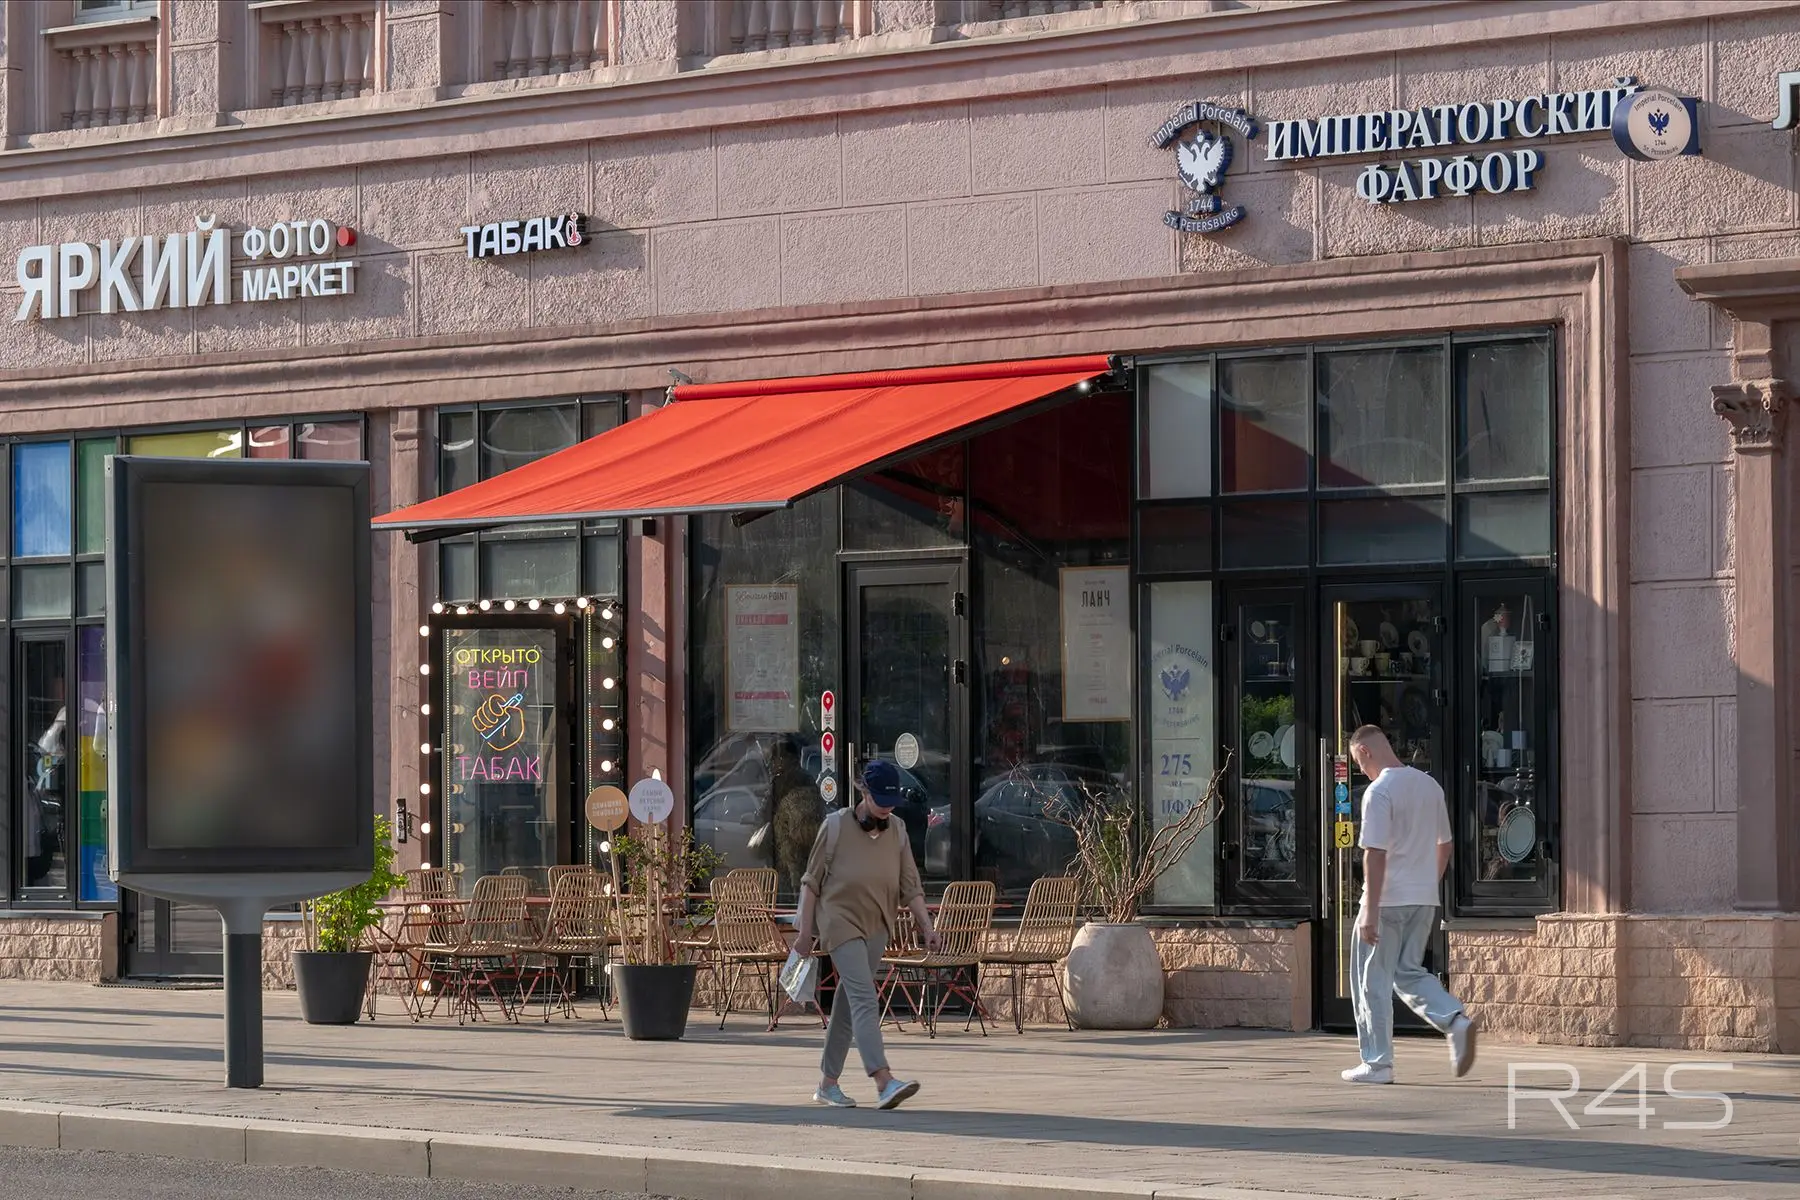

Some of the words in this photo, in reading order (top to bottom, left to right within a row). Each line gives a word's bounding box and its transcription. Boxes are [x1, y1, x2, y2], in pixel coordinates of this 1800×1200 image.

[1633, 94, 1657, 112] Imperial
[1657, 93, 1683, 112] Porcelain
[1152, 103, 1197, 146] Imperial
[1200, 102, 1251, 137] Porcelain
[1265, 77, 1637, 161] ИМПЕРАТОРСКИЙ
[1357, 149, 1541, 205] ФАРФОР
[1189, 200, 1214, 212] 1744
[1180, 208, 1239, 232] PETERSBURG
[243, 219, 334, 260] ФОТО
[461, 216, 567, 258] ТАБАК
[15, 214, 231, 322] ЯРКИЙ
[243, 261, 358, 302] МАРКЕТ
[1081, 589, 1110, 607] ЛАНЧ
[456, 648, 540, 664] ОТКРЫТО
[1175, 644, 1209, 668] Porcelain
[468, 666, 529, 689] ВЕЙП
[456, 755, 542, 782] ТАБАК
[1161, 754, 1192, 775] 275
